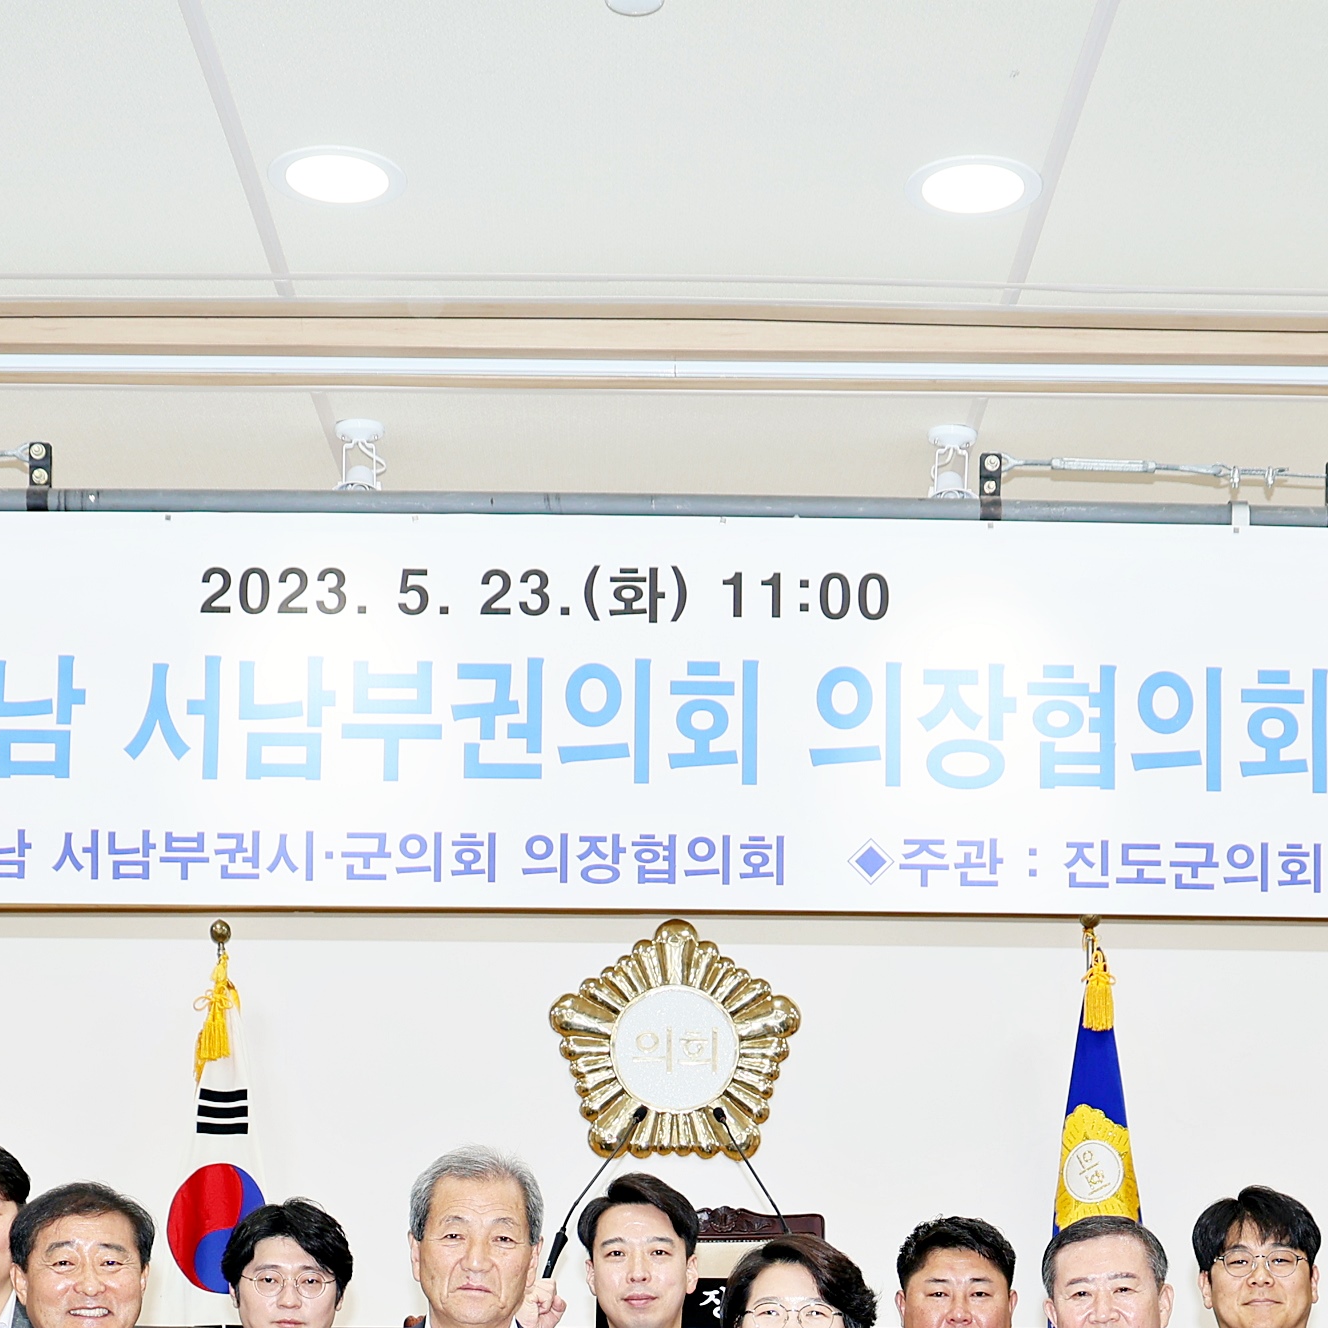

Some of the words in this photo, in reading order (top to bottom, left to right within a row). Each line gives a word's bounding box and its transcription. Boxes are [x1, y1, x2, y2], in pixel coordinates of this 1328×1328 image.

[199, 566, 368, 615] 2023.
[397, 567, 450, 616] 5.
[479, 564, 689, 624] 23.(화)
[721, 571, 891, 622] 11:00
[123, 655, 761, 788] 서남부권의회
[52, 828, 498, 883] 서남부권시·군의회
[521, 832, 787, 887] 의장협의회
[898, 837, 1005, 888] 주관
[1063, 838, 1324, 894] 진도군의회
[631, 1025, 719, 1076] 의회
